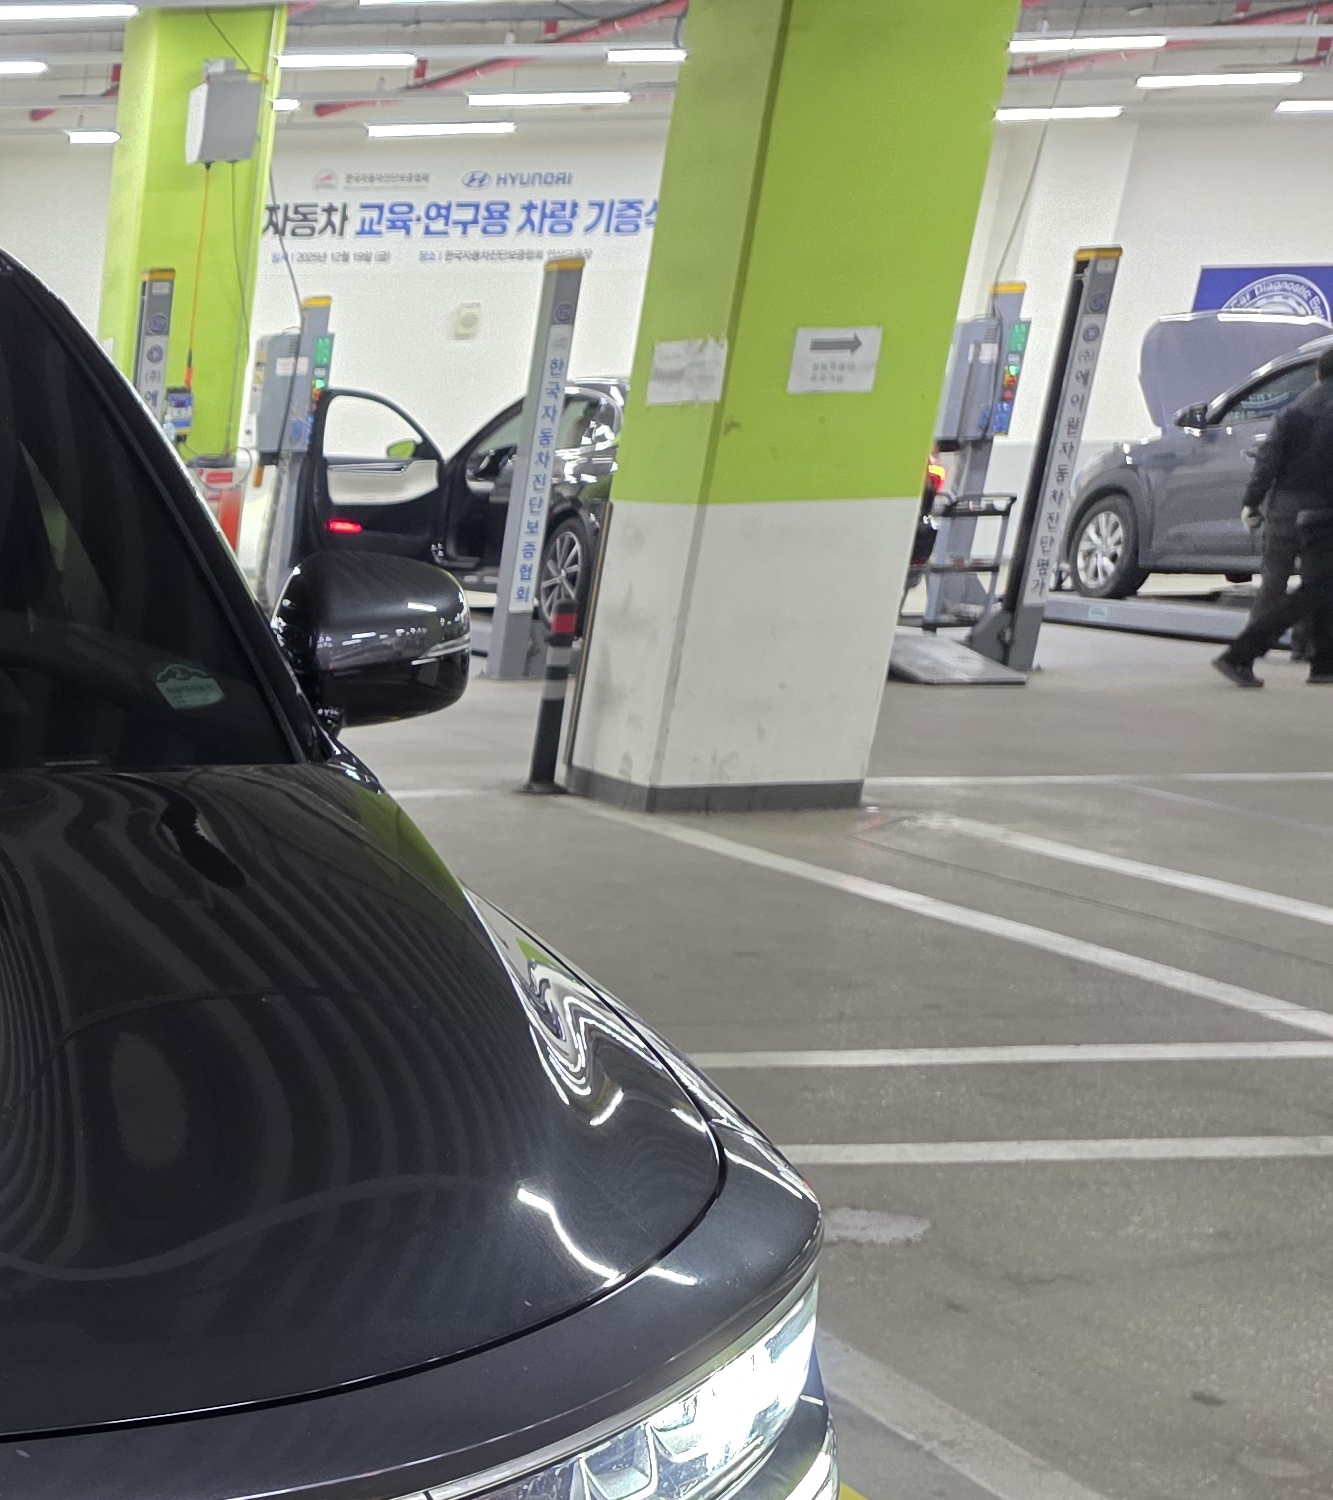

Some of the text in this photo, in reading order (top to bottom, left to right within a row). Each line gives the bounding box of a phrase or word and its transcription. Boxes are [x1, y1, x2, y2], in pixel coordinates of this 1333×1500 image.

[495, 171, 573, 187] HYUNDAI
[262, 202, 349, 238] 자동차
[355, 201, 510, 237] 교육·연구용
[516, 199, 579, 236] 차량
